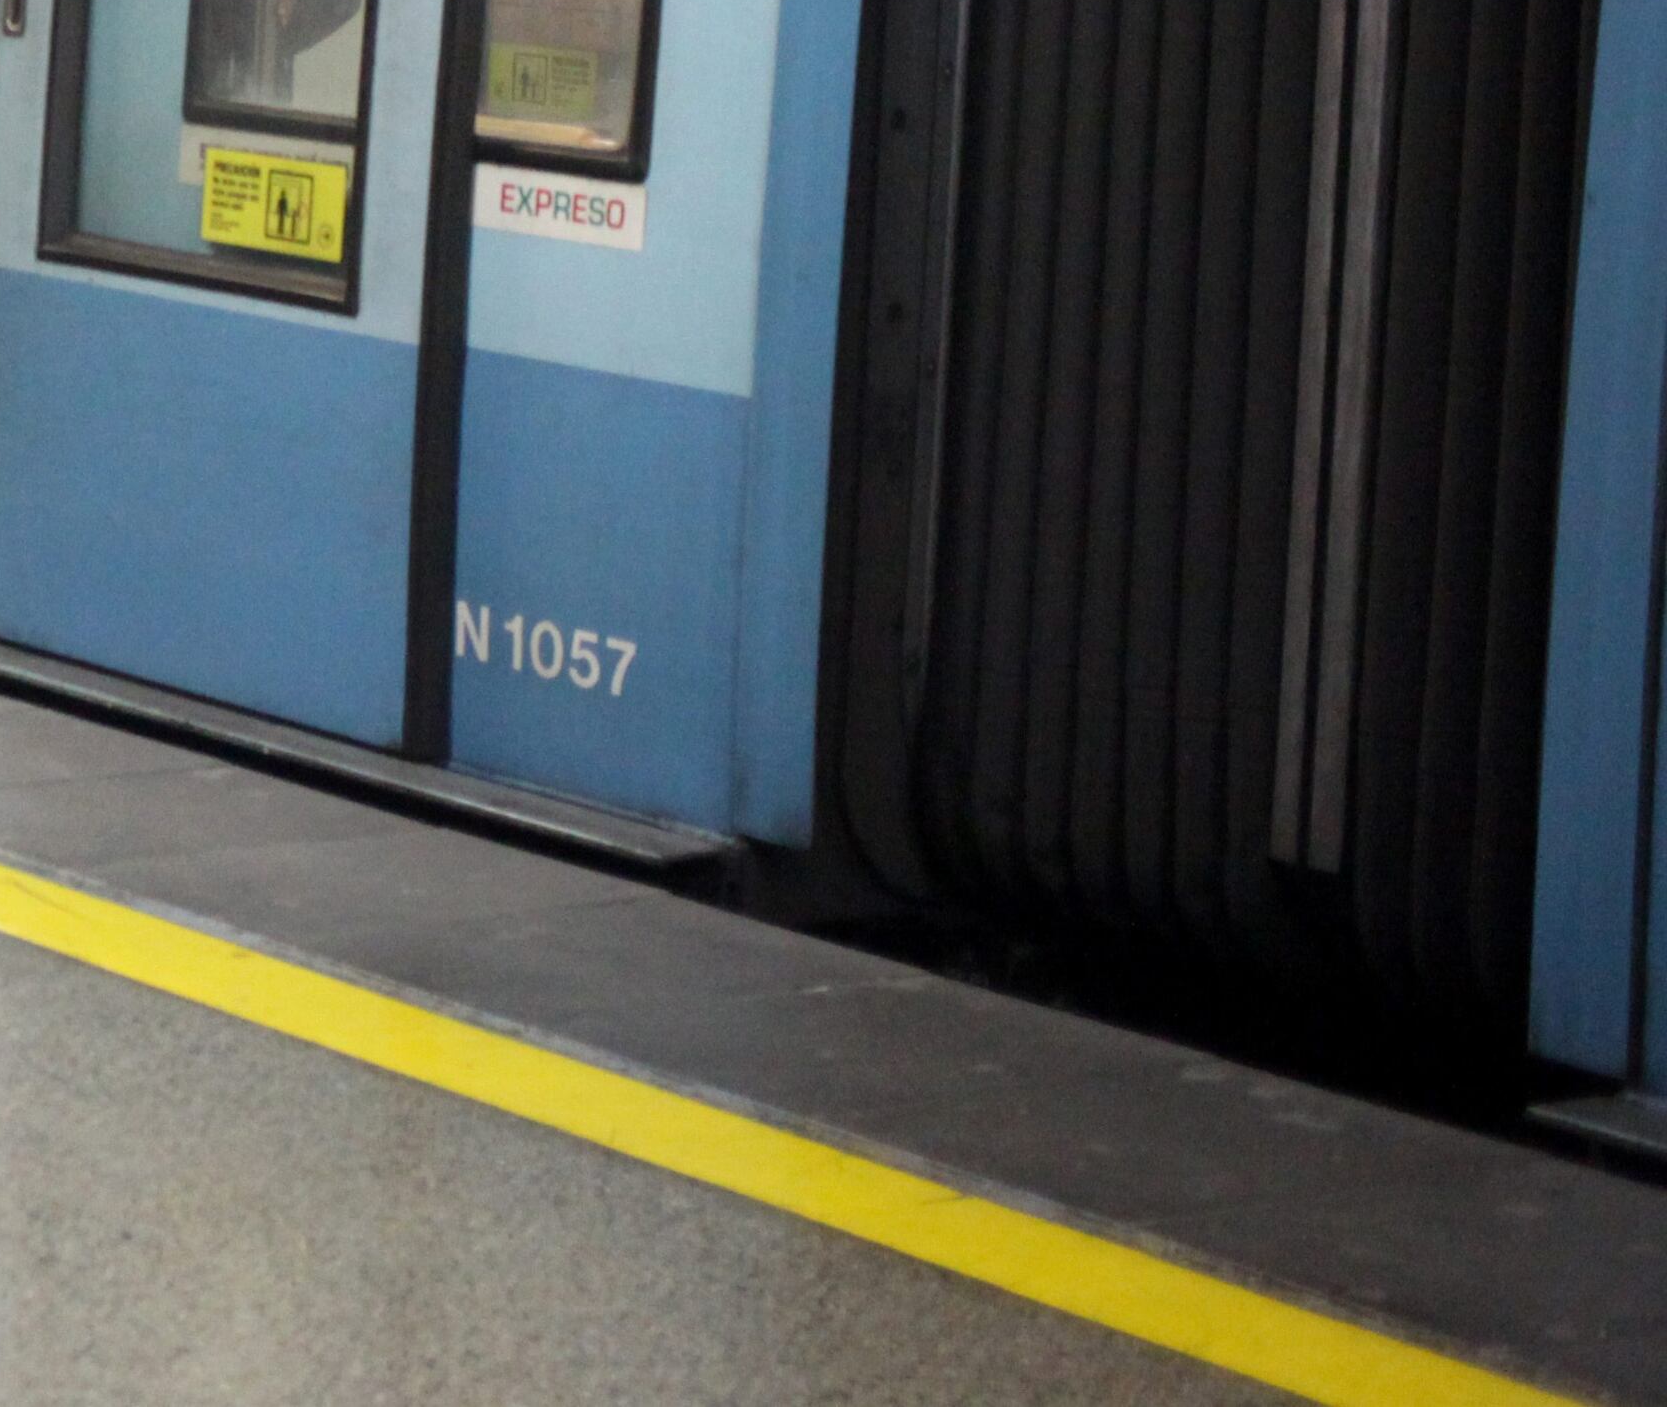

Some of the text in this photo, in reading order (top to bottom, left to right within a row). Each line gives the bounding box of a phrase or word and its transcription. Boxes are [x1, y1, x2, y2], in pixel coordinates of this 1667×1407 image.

[499, 181, 626, 230] EXPRESO
[454, 599, 638, 697] N 1057
